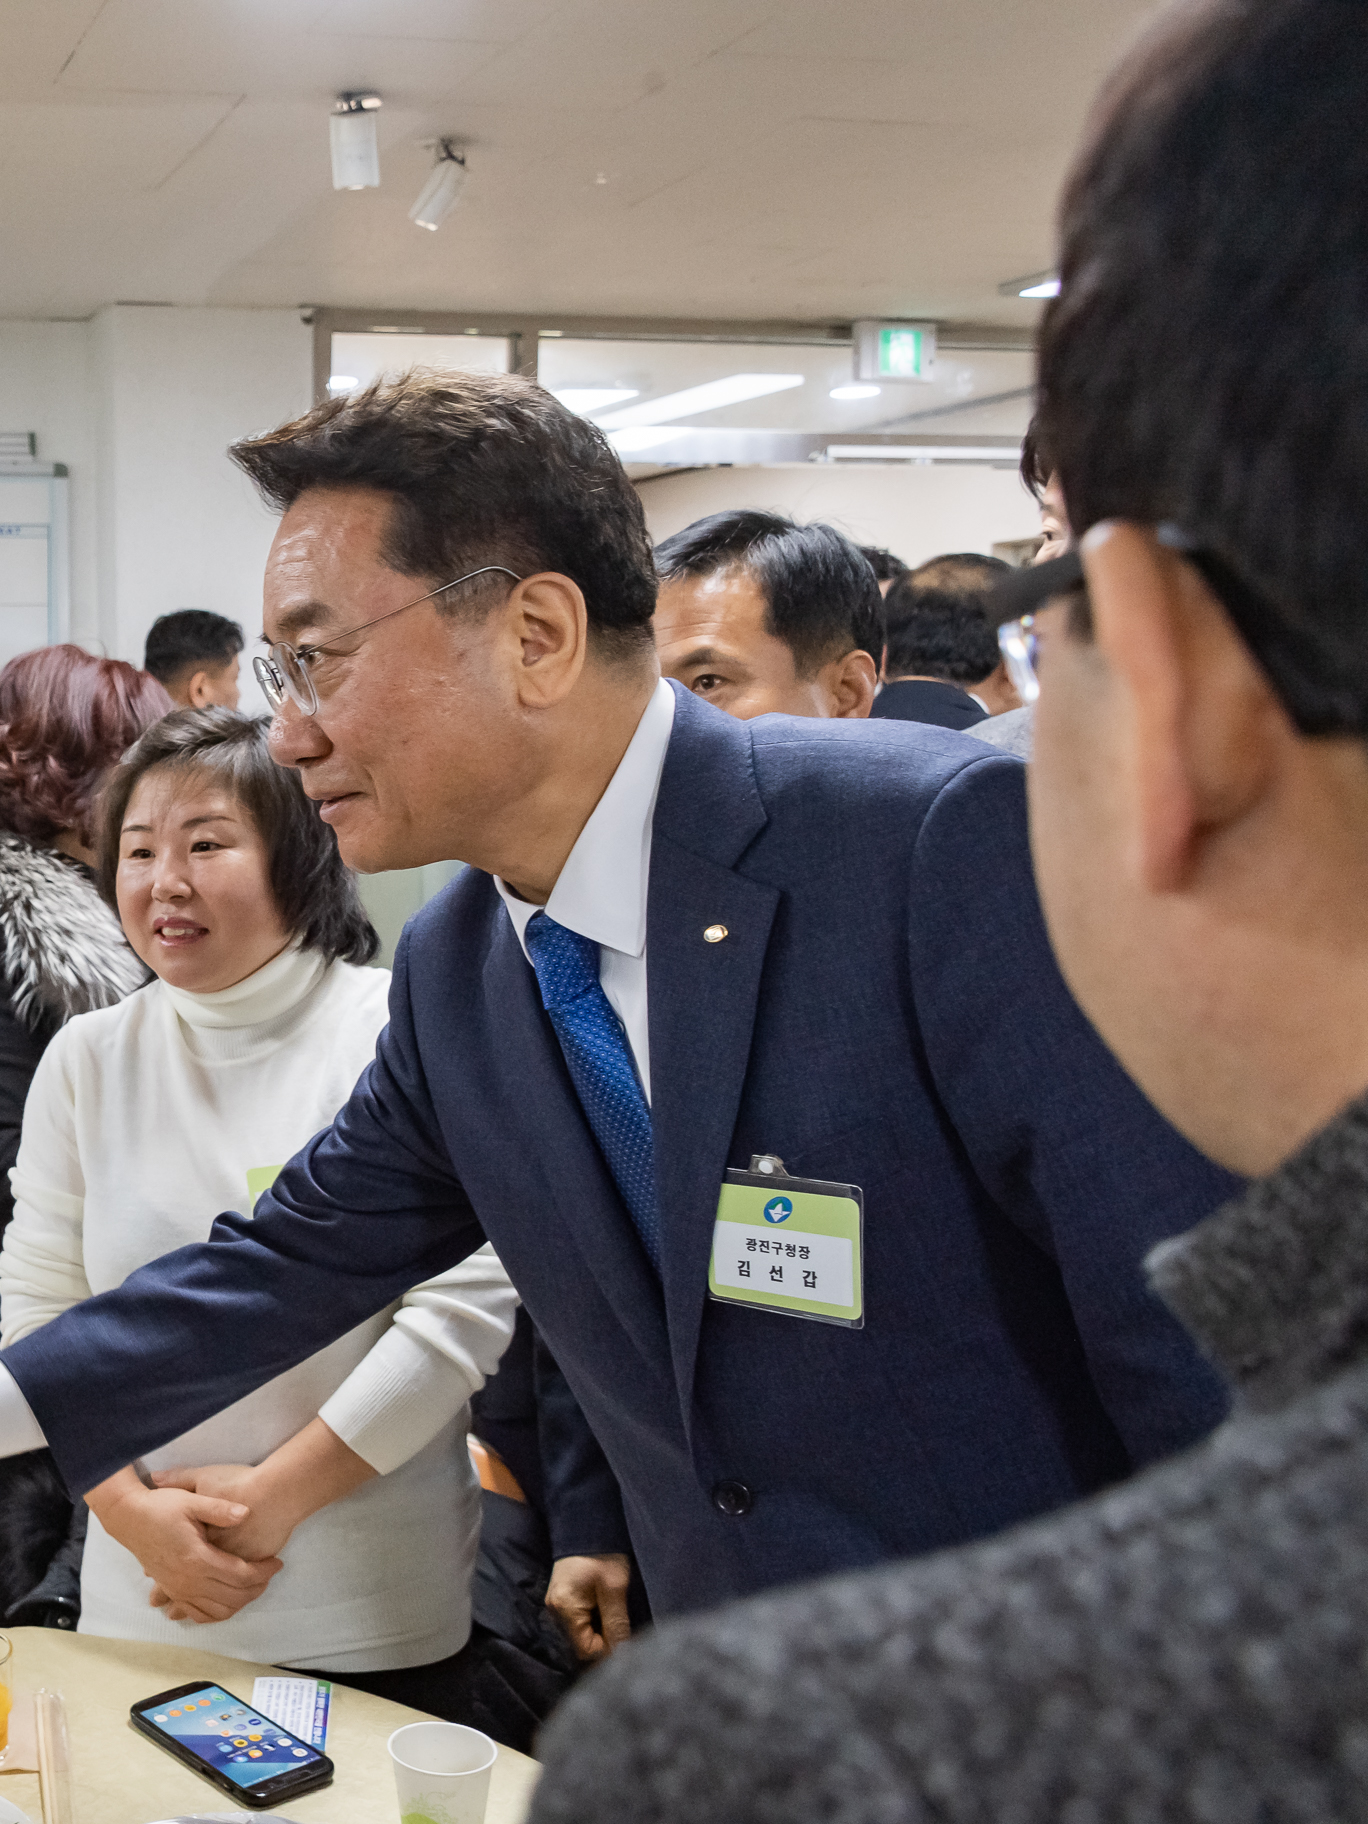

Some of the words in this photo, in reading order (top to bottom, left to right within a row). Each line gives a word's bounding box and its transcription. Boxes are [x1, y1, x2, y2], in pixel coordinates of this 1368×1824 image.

[745, 1237, 811, 1260] 광진구청장
[737, 1260, 751, 1278] 김
[769, 1265, 784, 1283] 선
[802, 1269, 818, 1289] 갑
